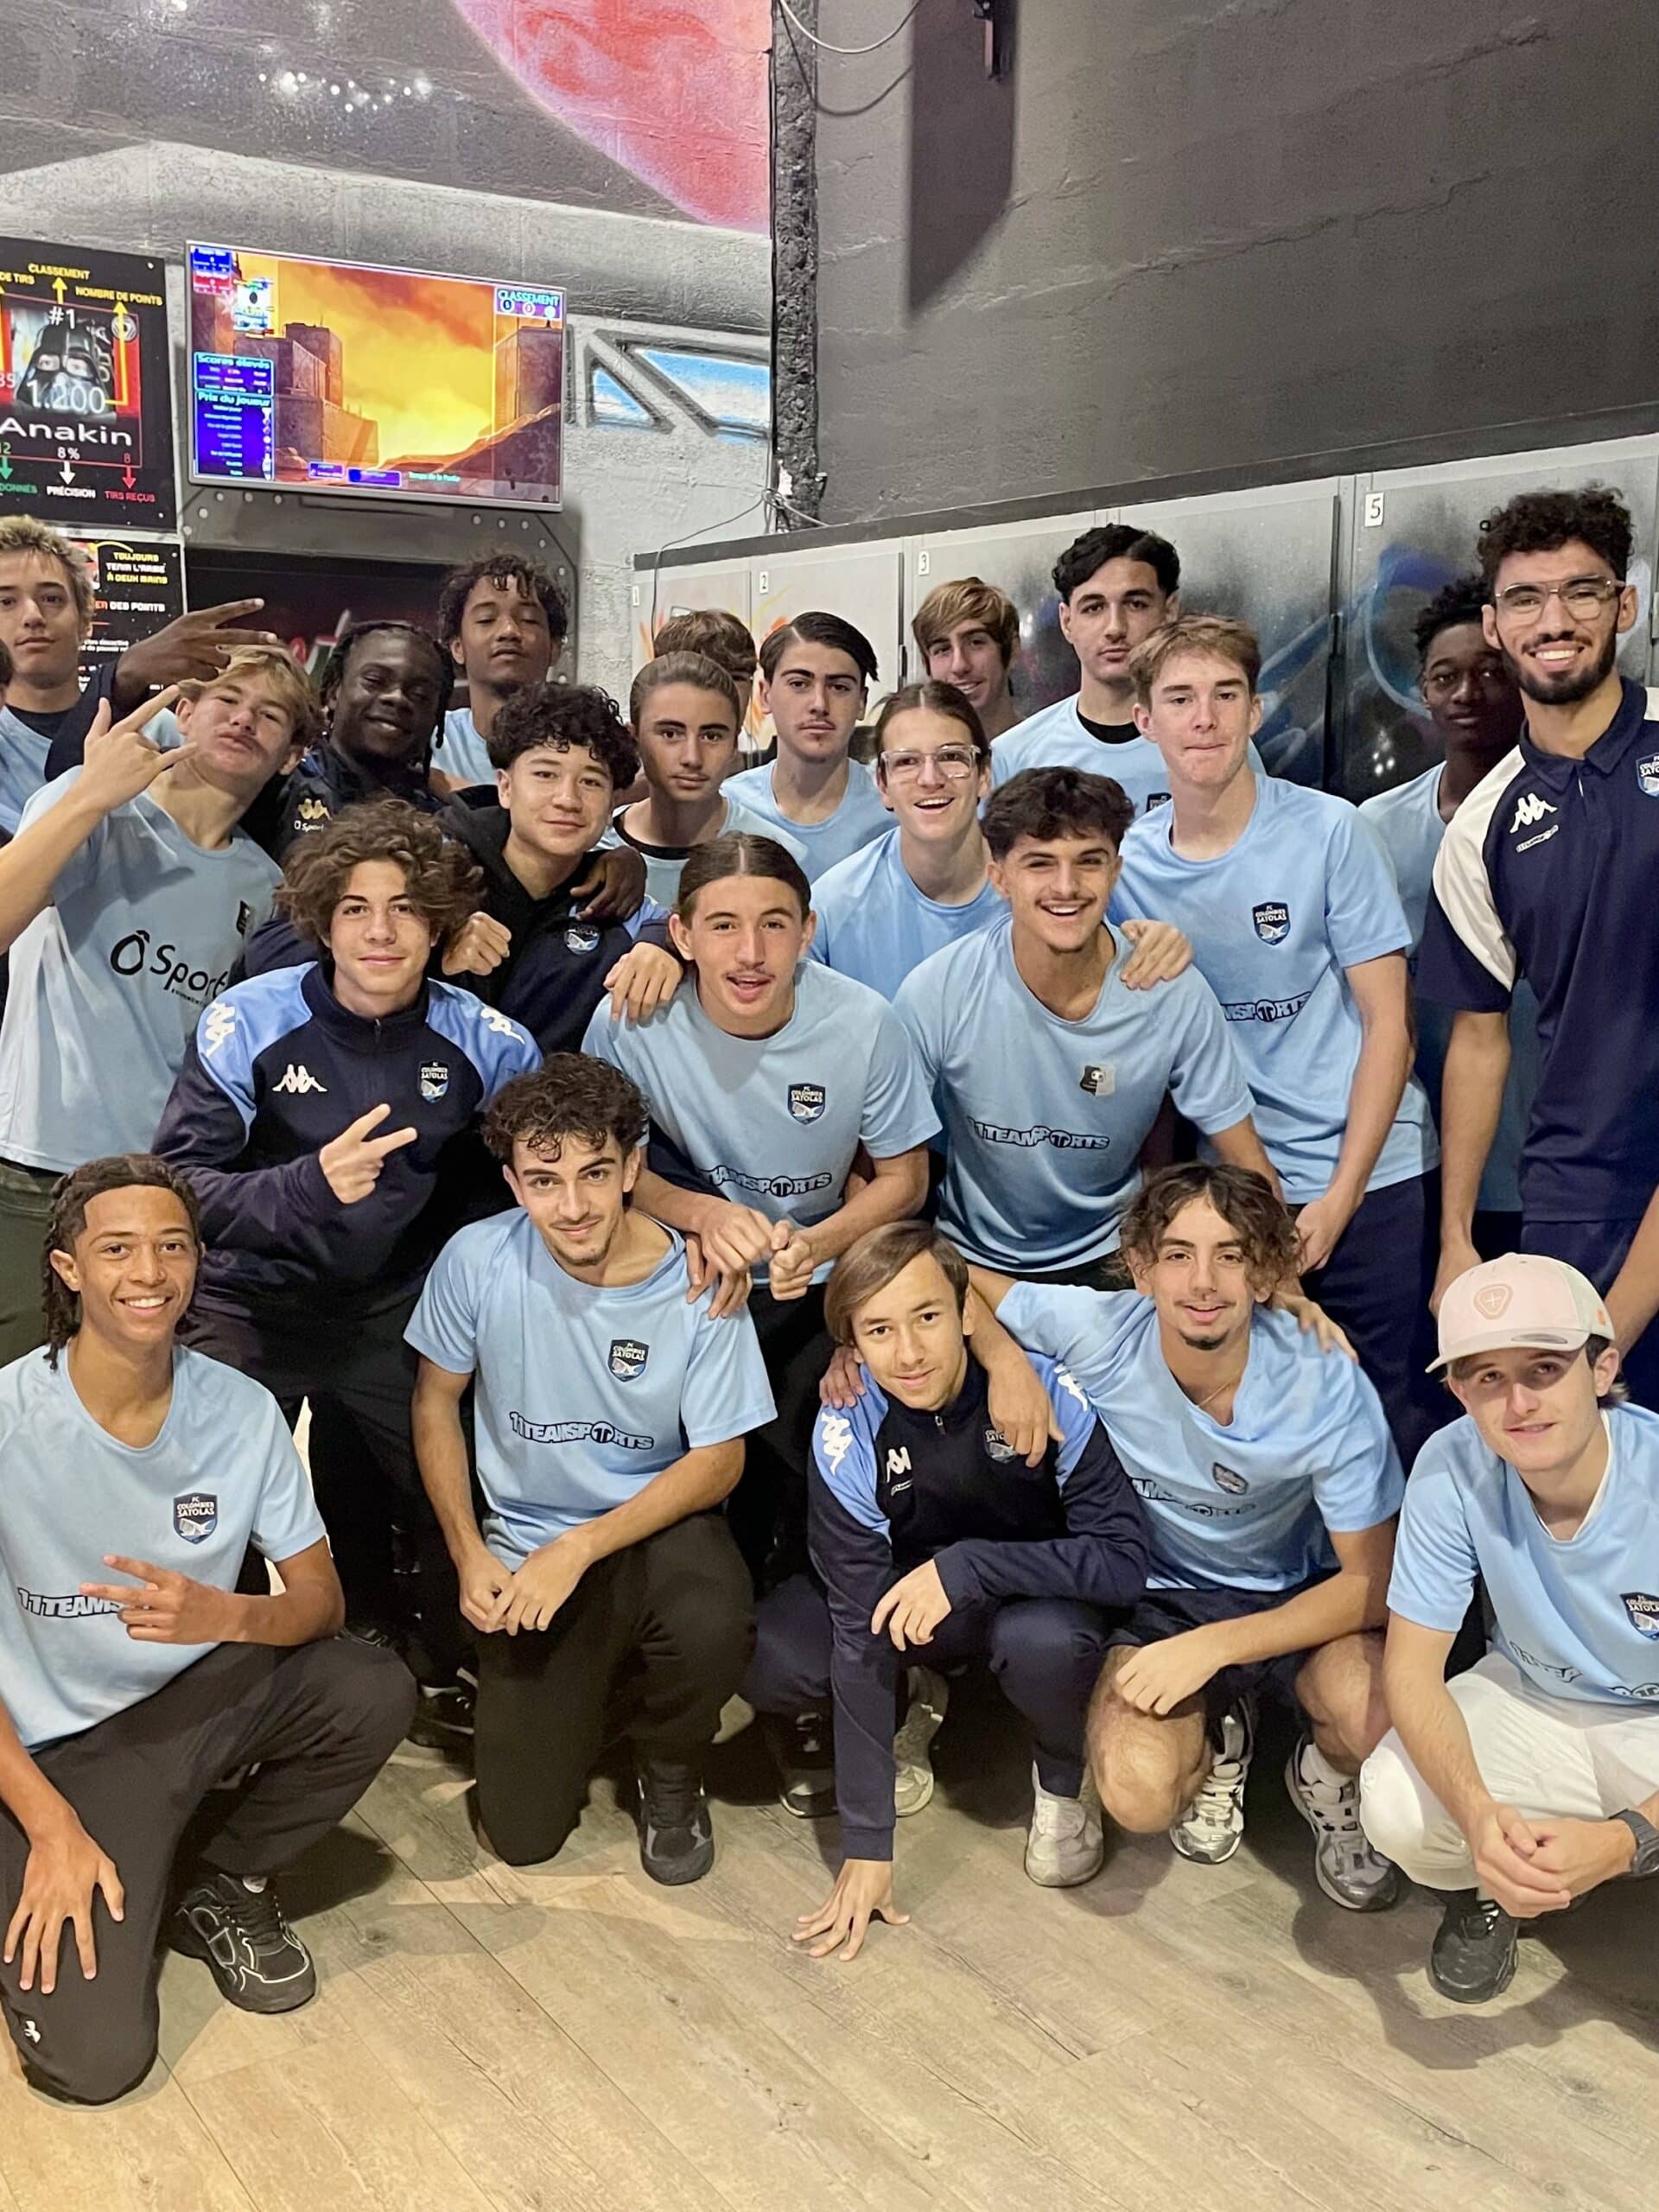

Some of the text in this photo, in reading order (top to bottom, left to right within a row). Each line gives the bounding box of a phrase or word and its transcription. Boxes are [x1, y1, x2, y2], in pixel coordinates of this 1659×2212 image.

[28, 263, 91, 280] CLASSEMENT
[13, 273, 35, 285] TIRS
[75, 286, 163, 307] NOMBRE DE POINTS
[498, 289, 559, 306] CLASSEMENT
[48, 305, 76, 329] #1
[198, 354, 270, 370] Scores élevés
[27, 379, 106, 415] 1.200
[199, 391, 270, 407] Prix du joueur
[0, 417, 133, 447] Anakin
[46, 484, 97, 499] PRÉCISION
[105, 490, 156, 504] TIRS REÇUS
[1370, 497, 1381, 519] 5
[113, 551, 159, 563] TOUJOURS
[921, 554, 927, 572] 3
[105, 563, 130, 573] TENIR
[106, 571, 168, 585] À DEUX MAINS
[109, 601, 130, 611] DES
[130, 601, 166, 613] POINTS
[1256, 914, 1287, 924] SATOLAS
[791, 1093, 823, 1103] SATOLAS
[613, 1349, 645, 1361] SATOLAS
[177, 1501, 215, 1510] COLOMBIER
[177, 1507, 215, 1518] SATOLAS
